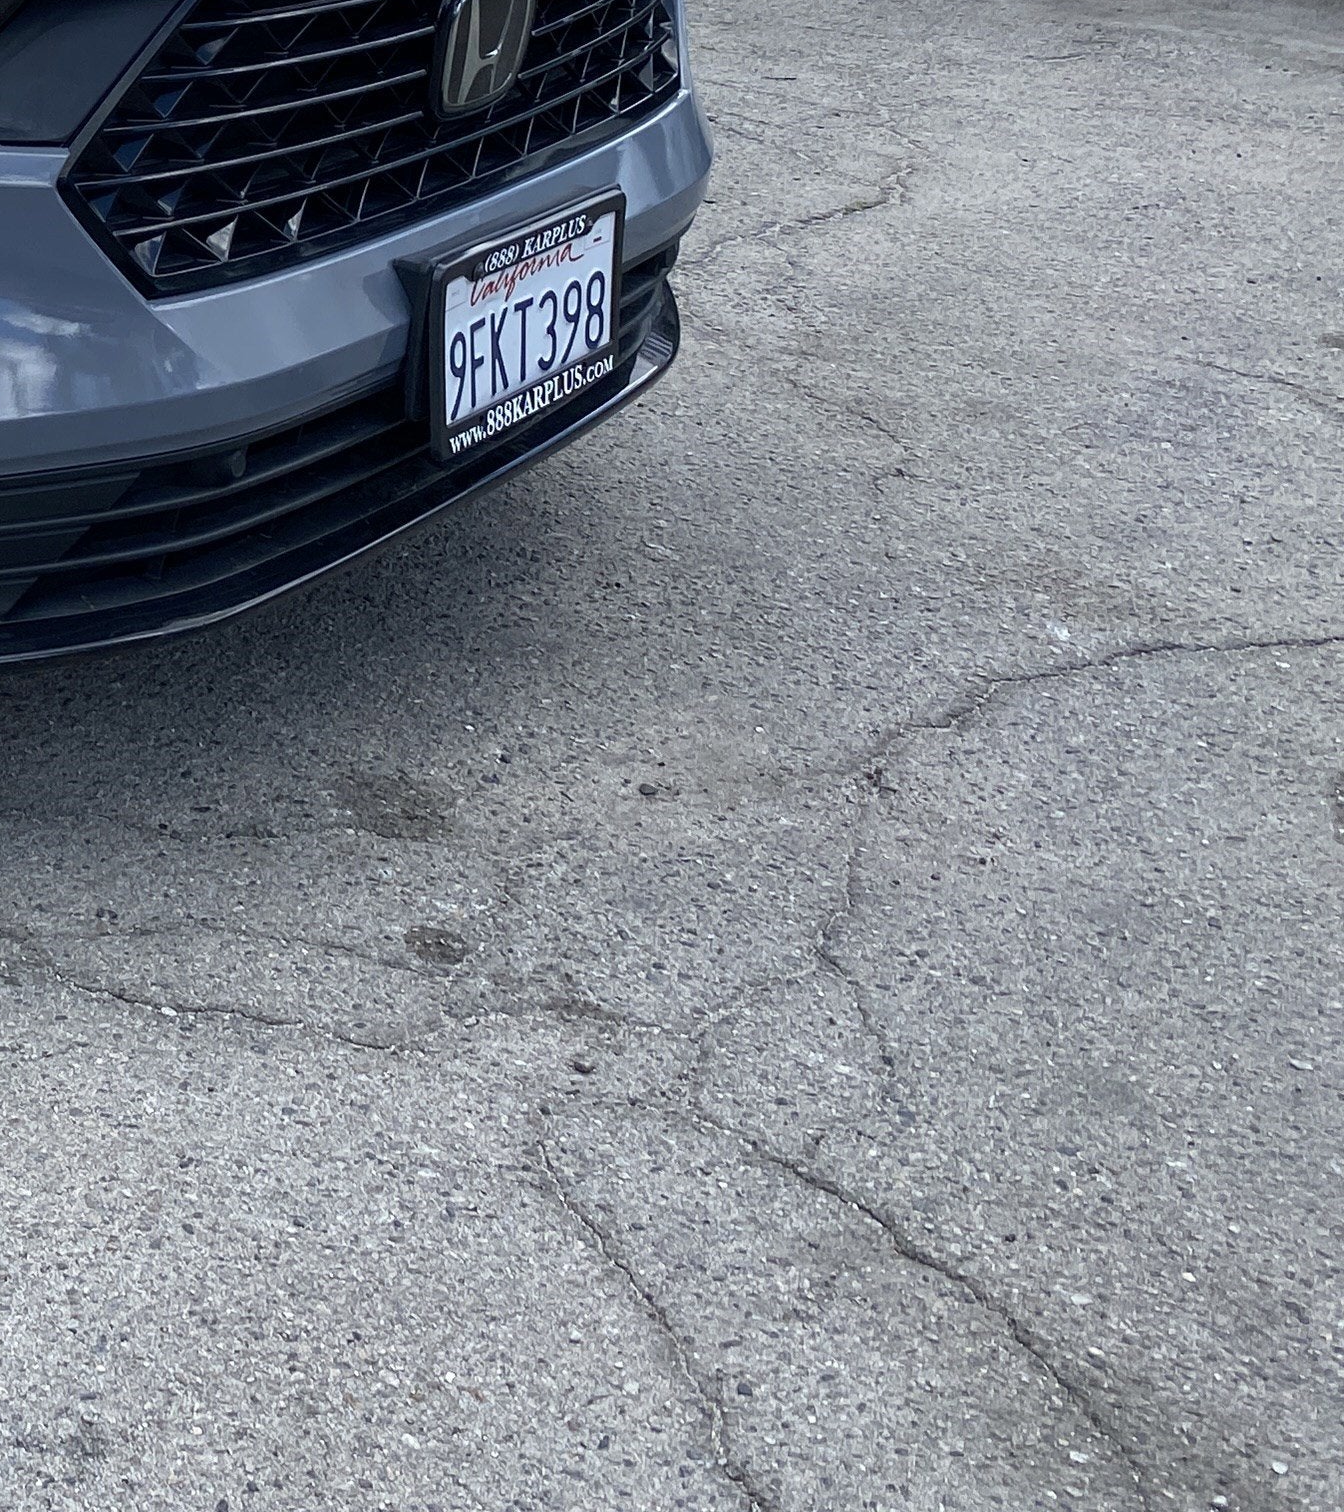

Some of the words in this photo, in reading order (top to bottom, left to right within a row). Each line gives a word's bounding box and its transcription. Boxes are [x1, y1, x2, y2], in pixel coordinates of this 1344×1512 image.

[484, 243, 520, 273] (888)
[521, 214, 587, 259] KARPLUS
[449, 270, 606, 421] 9FKT398
